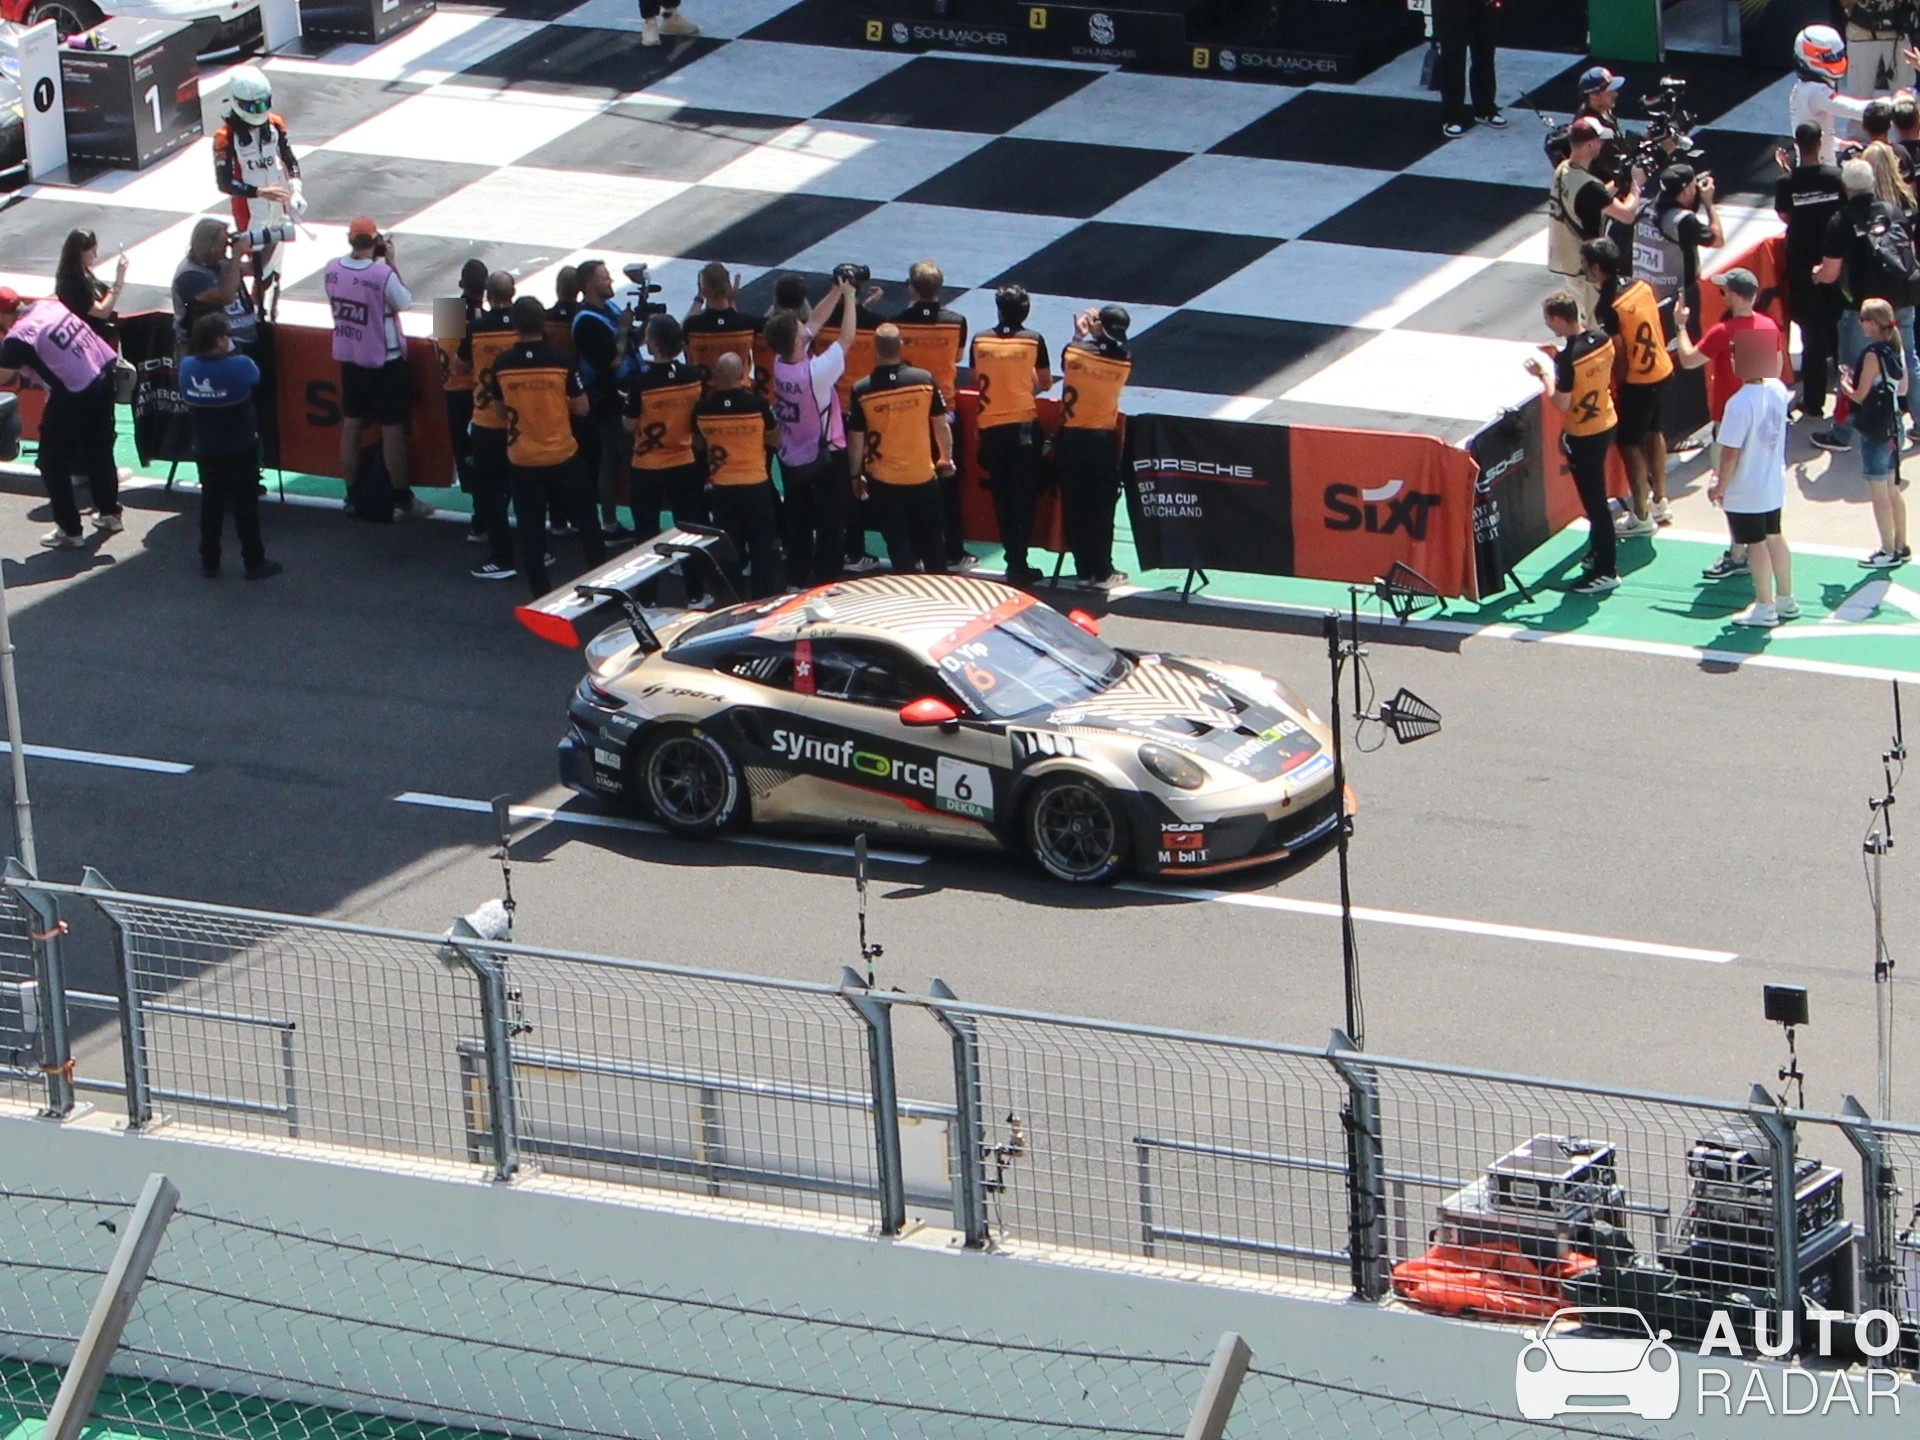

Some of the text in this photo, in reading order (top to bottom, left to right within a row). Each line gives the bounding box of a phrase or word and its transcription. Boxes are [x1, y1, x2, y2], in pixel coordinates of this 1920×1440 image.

[1032, 10, 1042, 25] 1
[869, 25, 879, 38] 2
[913, 26, 1007, 45] SCHUMACHER
[1196, 53, 1206, 66] 3
[1241, 53, 1338, 72] SCHUMACHER
[39, 84, 48, 106] 1
[144, 84, 163, 134] 1
[1175, 493, 1198, 505] CUP
[963, 662, 996, 693] 6
[954, 773, 972, 801] 6
[946, 799, 984, 817] DEKRA
